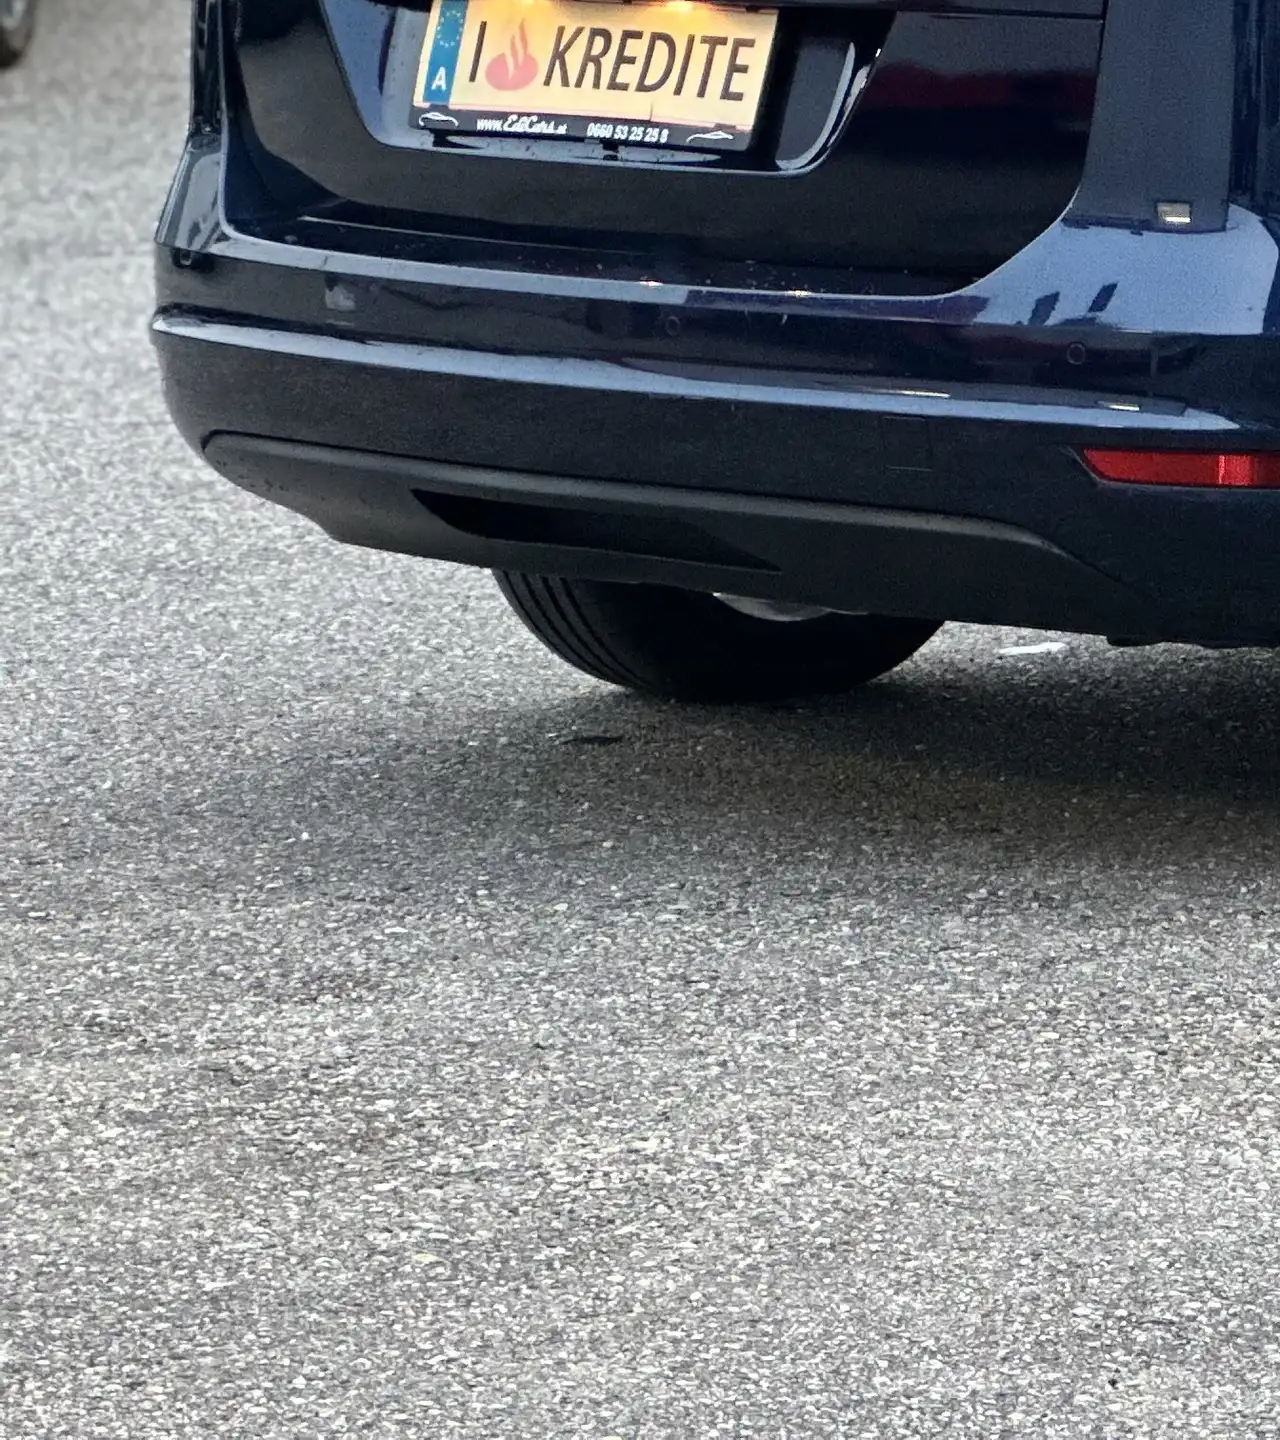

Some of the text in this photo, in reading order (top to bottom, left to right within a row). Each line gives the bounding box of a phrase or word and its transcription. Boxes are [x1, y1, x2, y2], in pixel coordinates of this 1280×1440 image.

[468, 20, 757, 102] I KREDITE
[430, 66, 448, 92] A
[586, 122, 614, 138] 0660
[614, 125, 629, 140] 53
[628, 126, 645, 141] 25
[643, 127, 660, 143] 25
